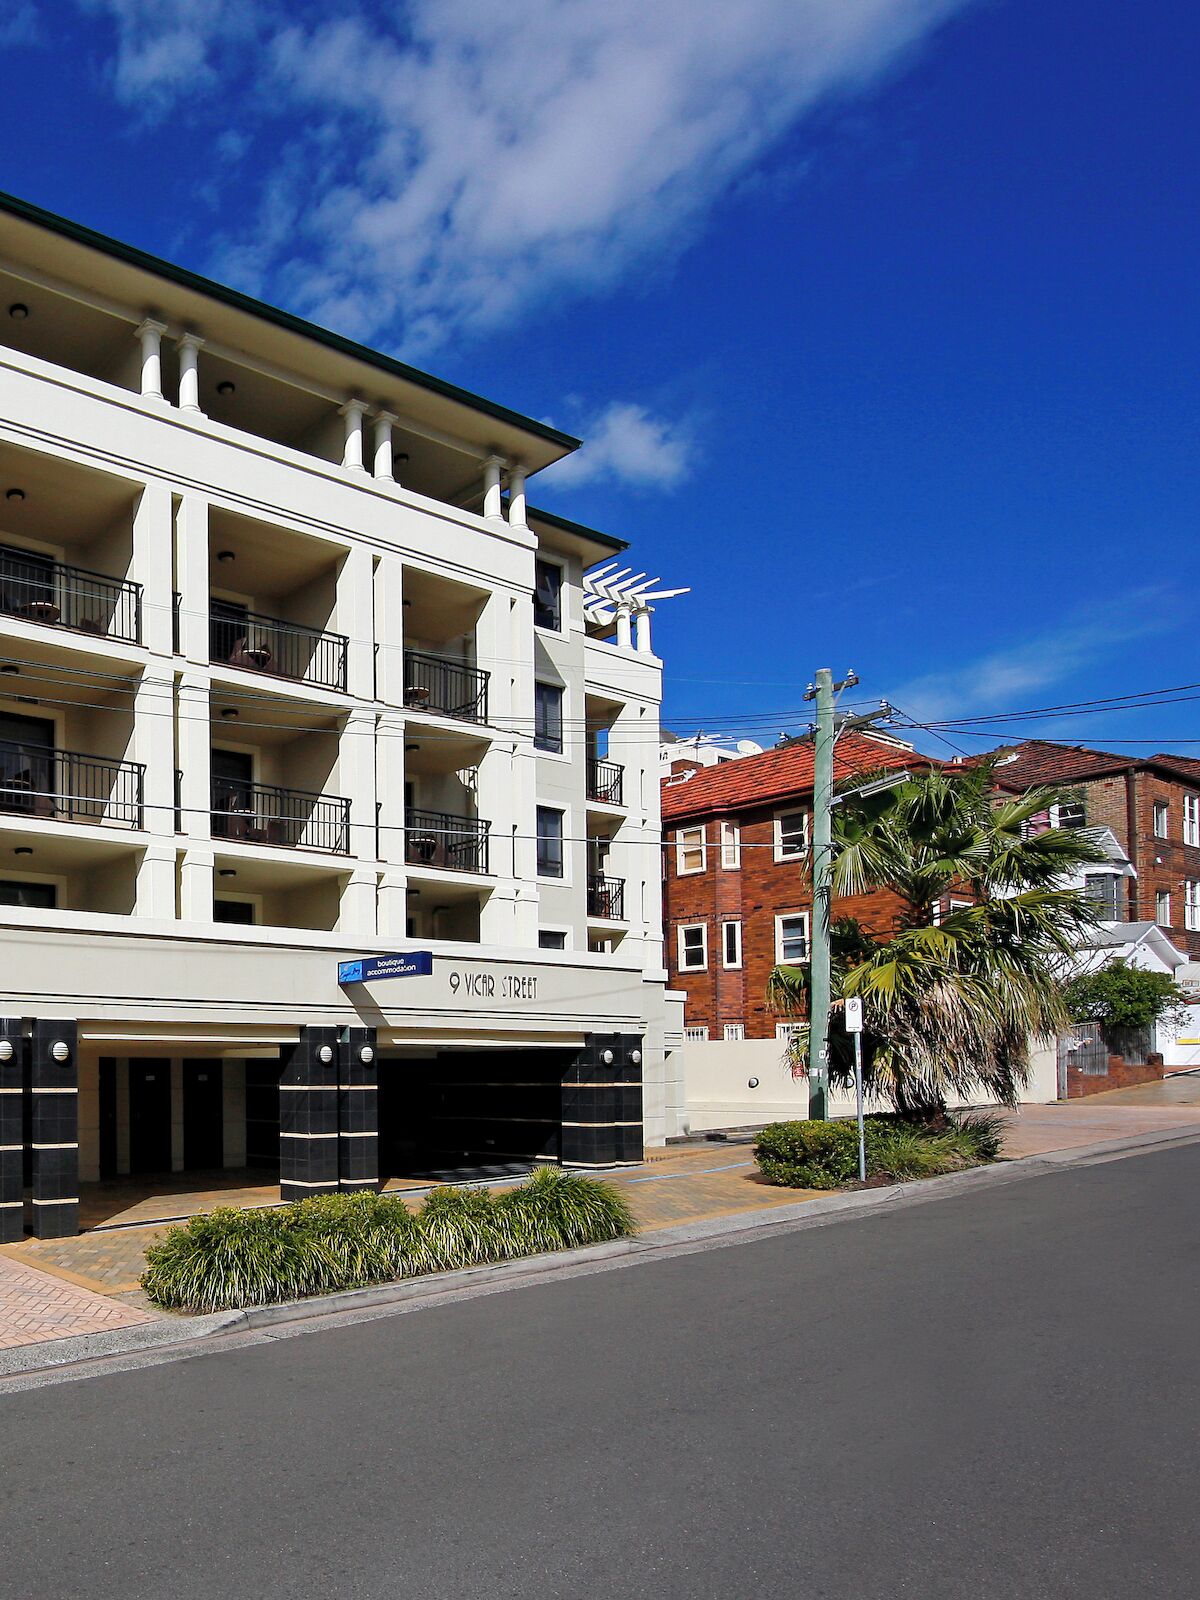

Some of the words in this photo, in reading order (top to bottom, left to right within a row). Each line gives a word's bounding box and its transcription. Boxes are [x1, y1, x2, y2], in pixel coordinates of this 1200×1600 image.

[377, 958, 405, 968] boutique
[366, 964, 417, 976] accommodation
[449, 971, 460, 995] 9
[464, 973, 495, 997] VICAR
[501, 975, 538, 999] STREET
